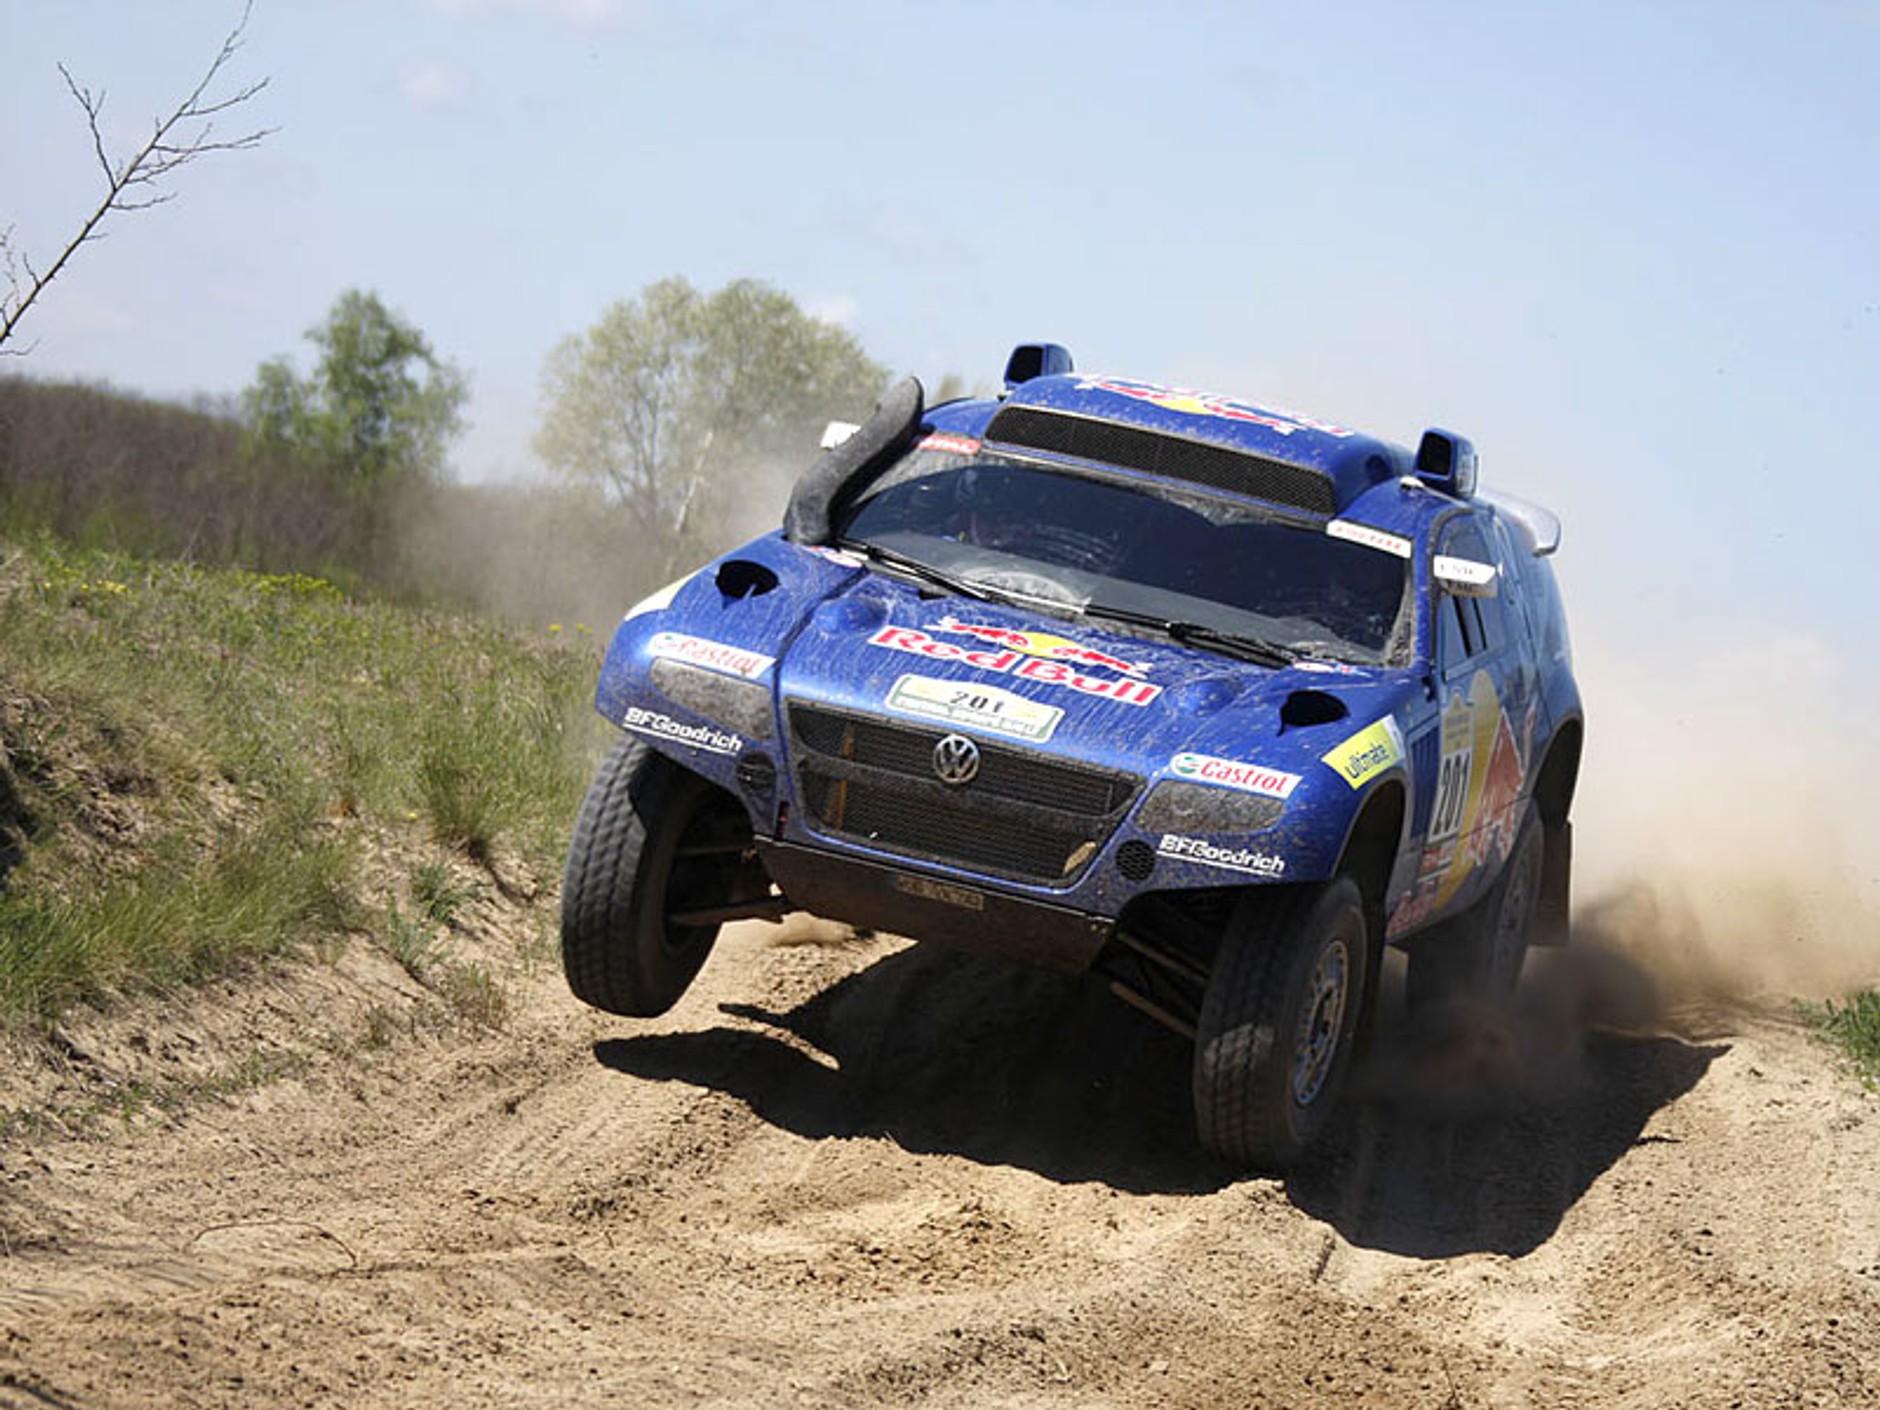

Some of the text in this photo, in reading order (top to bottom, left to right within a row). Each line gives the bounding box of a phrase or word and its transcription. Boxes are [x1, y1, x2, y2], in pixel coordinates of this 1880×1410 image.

[870, 627, 1161, 706] Red Bull
[950, 689, 1005, 713] 201
[624, 706, 743, 753] BFGoodrich
[1200, 761, 1289, 794] Castrol
[1432, 751, 1470, 836] 201
[1159, 833, 1286, 873] BFGoodrich
